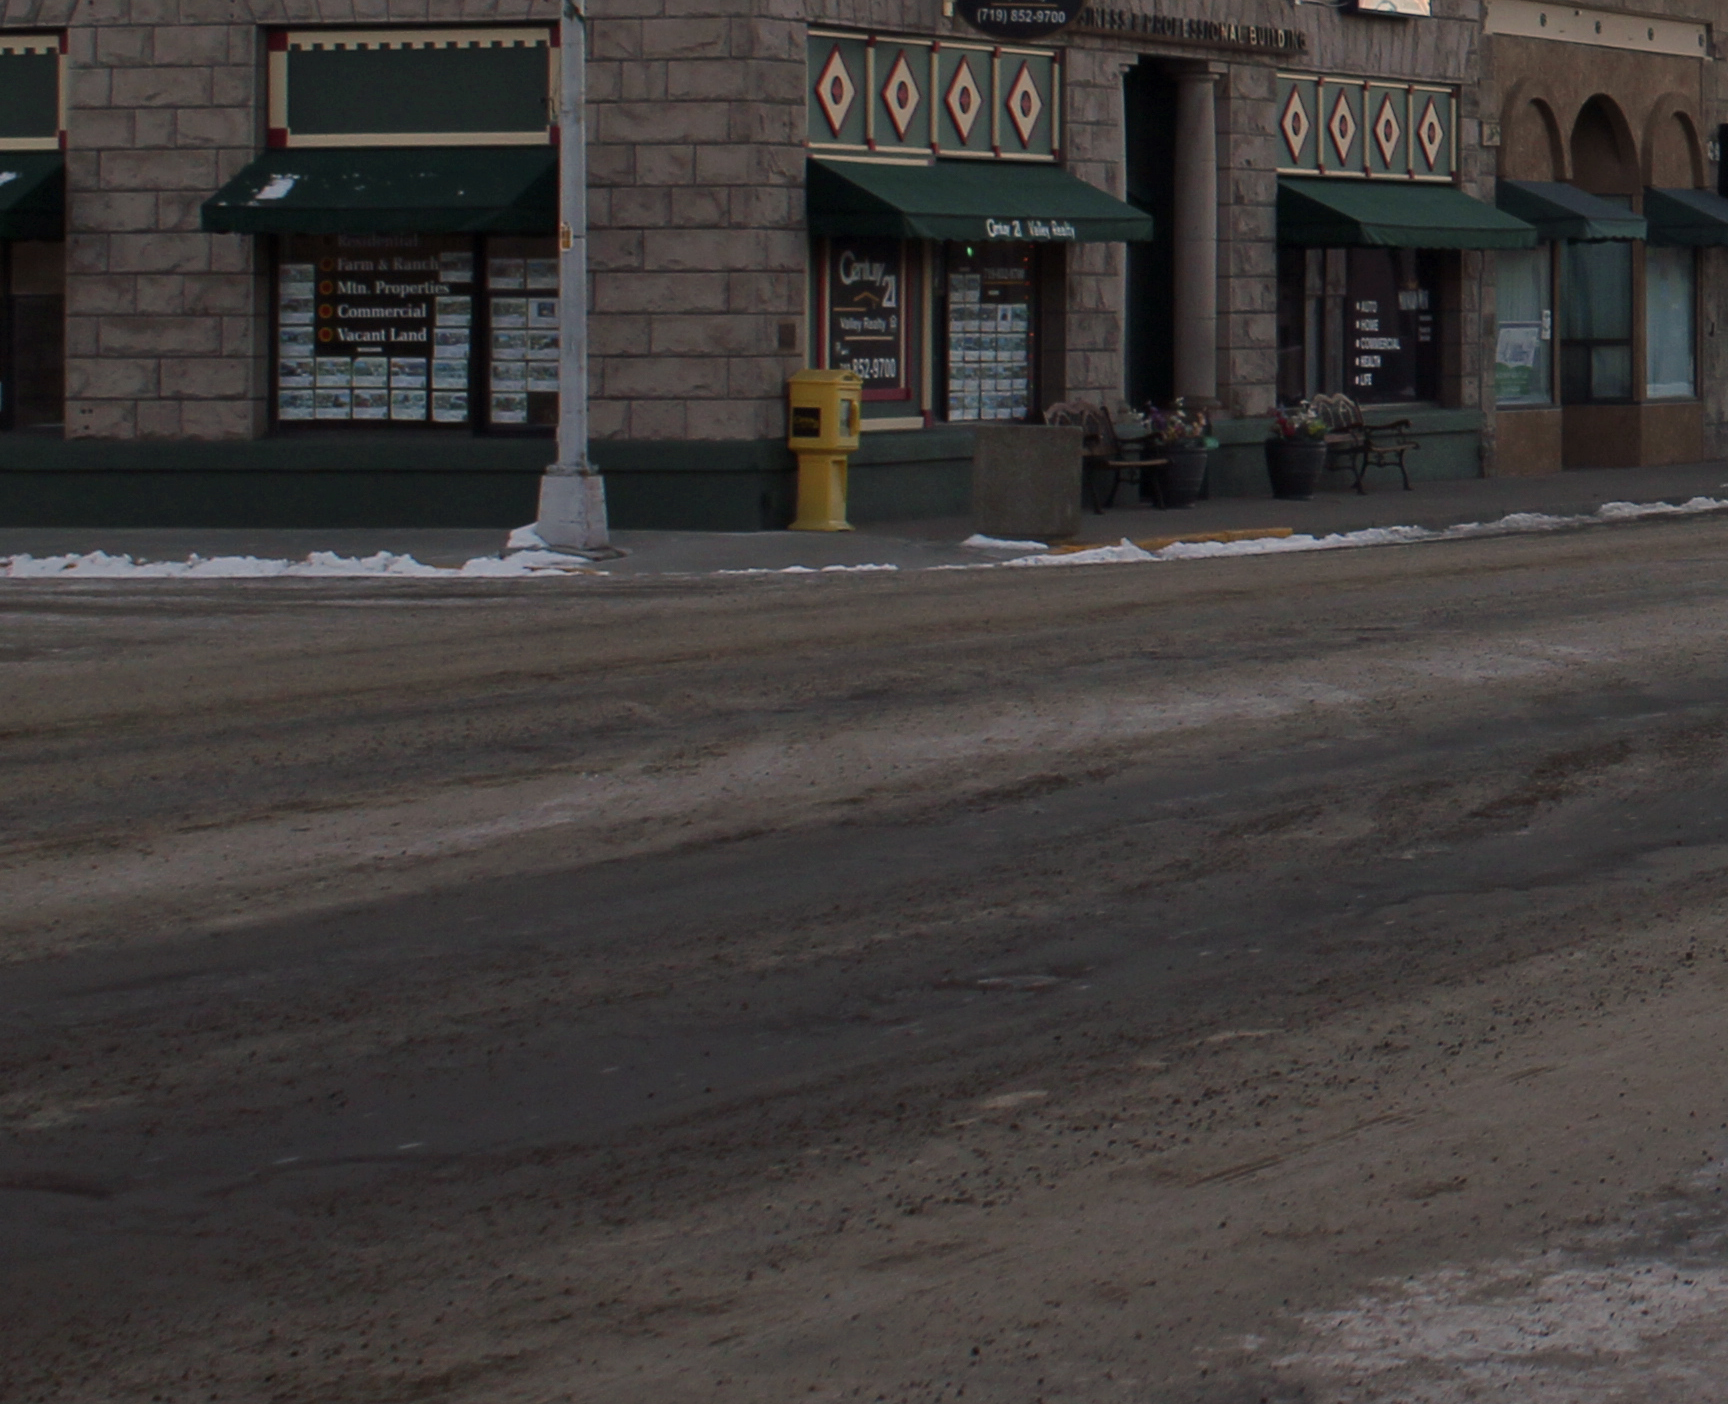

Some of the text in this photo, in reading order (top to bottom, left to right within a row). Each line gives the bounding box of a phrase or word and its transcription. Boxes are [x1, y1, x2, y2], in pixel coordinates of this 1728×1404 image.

[977, 8, 1066, 24] (719) 852-9700
[1012, 220, 1023, 238] 21
[338, 256, 439, 271] Farm & Ranch
[840, 250, 886, 286] Century
[337, 280, 450, 298] Mtn. Properties
[882, 275, 896, 308] 21
[337, 303, 427, 318] Commercial
[337, 327, 427, 342] Vacant Land
[852, 358, 896, 379] 852-9700
